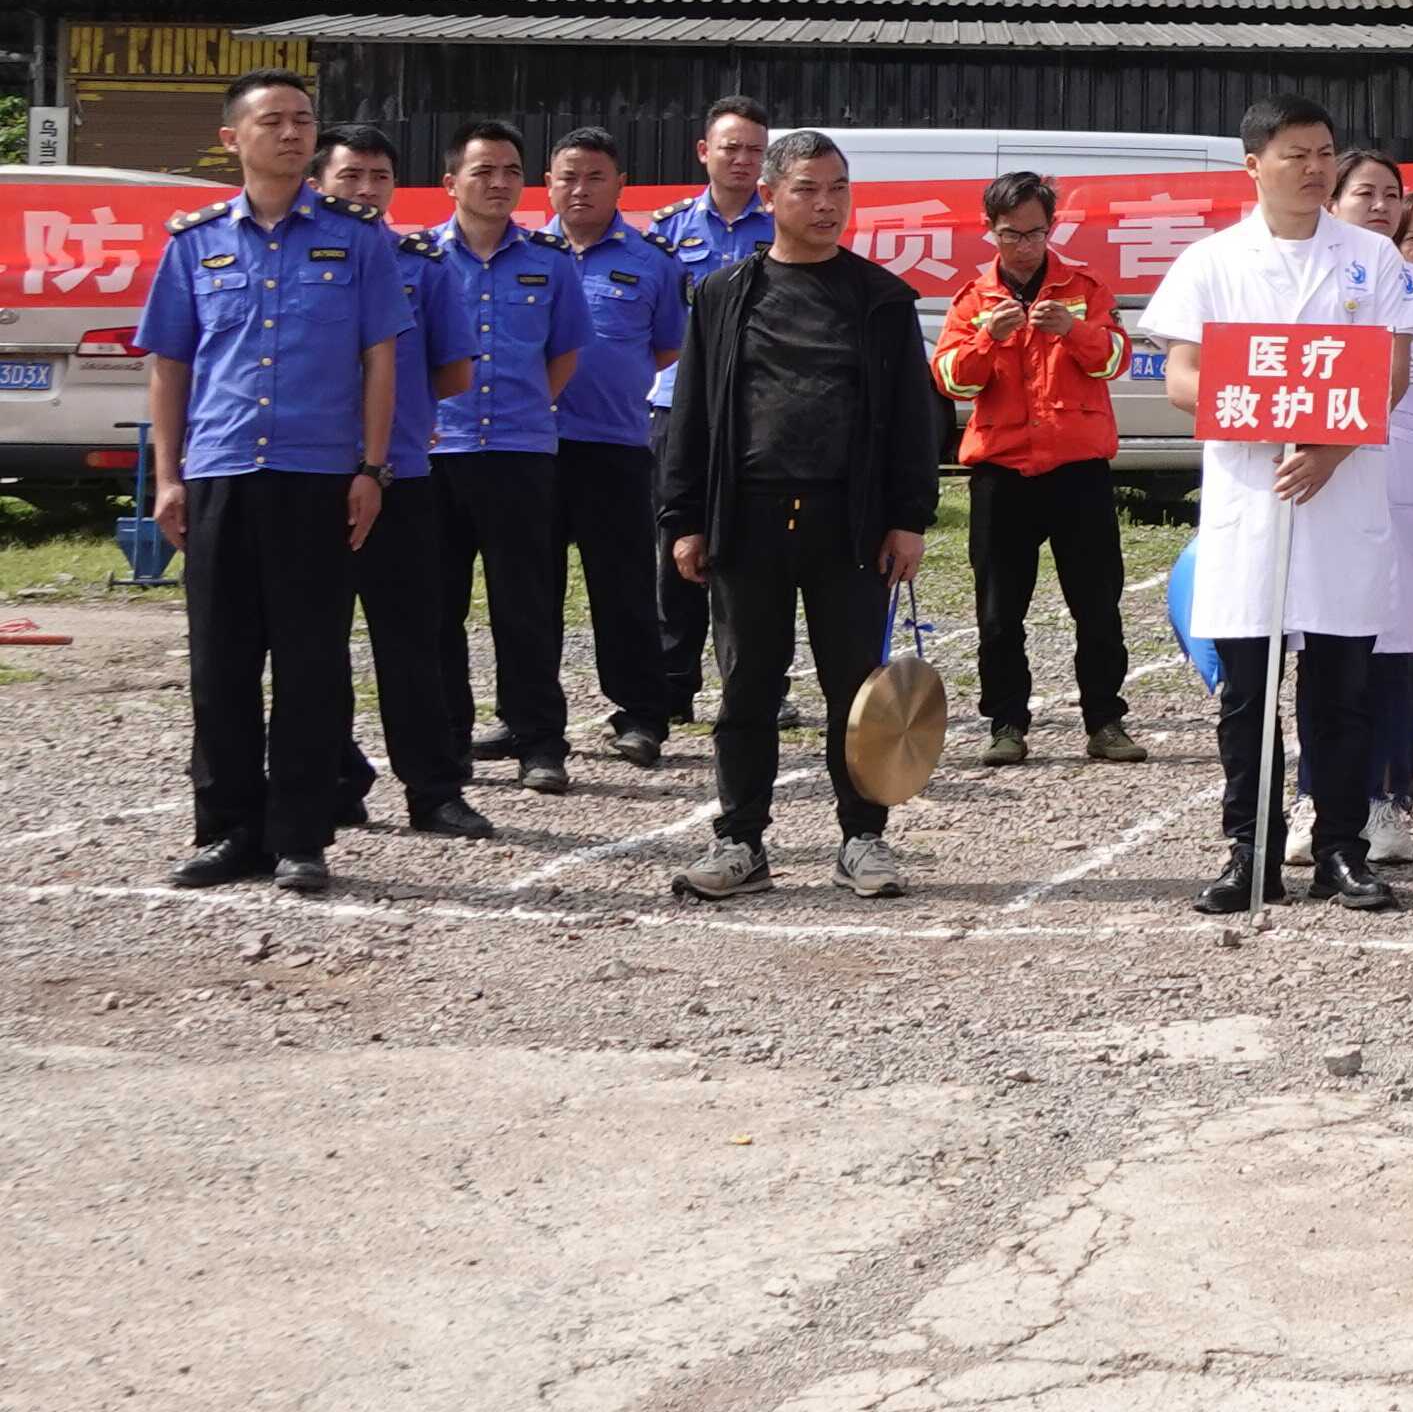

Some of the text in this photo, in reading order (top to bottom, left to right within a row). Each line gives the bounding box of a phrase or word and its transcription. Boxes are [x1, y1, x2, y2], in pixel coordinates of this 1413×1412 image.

[39, 119, 58, 165] 乌当
[1248, 336, 1345, 379] 医疗
[1215, 385, 1368, 430] 救护队
